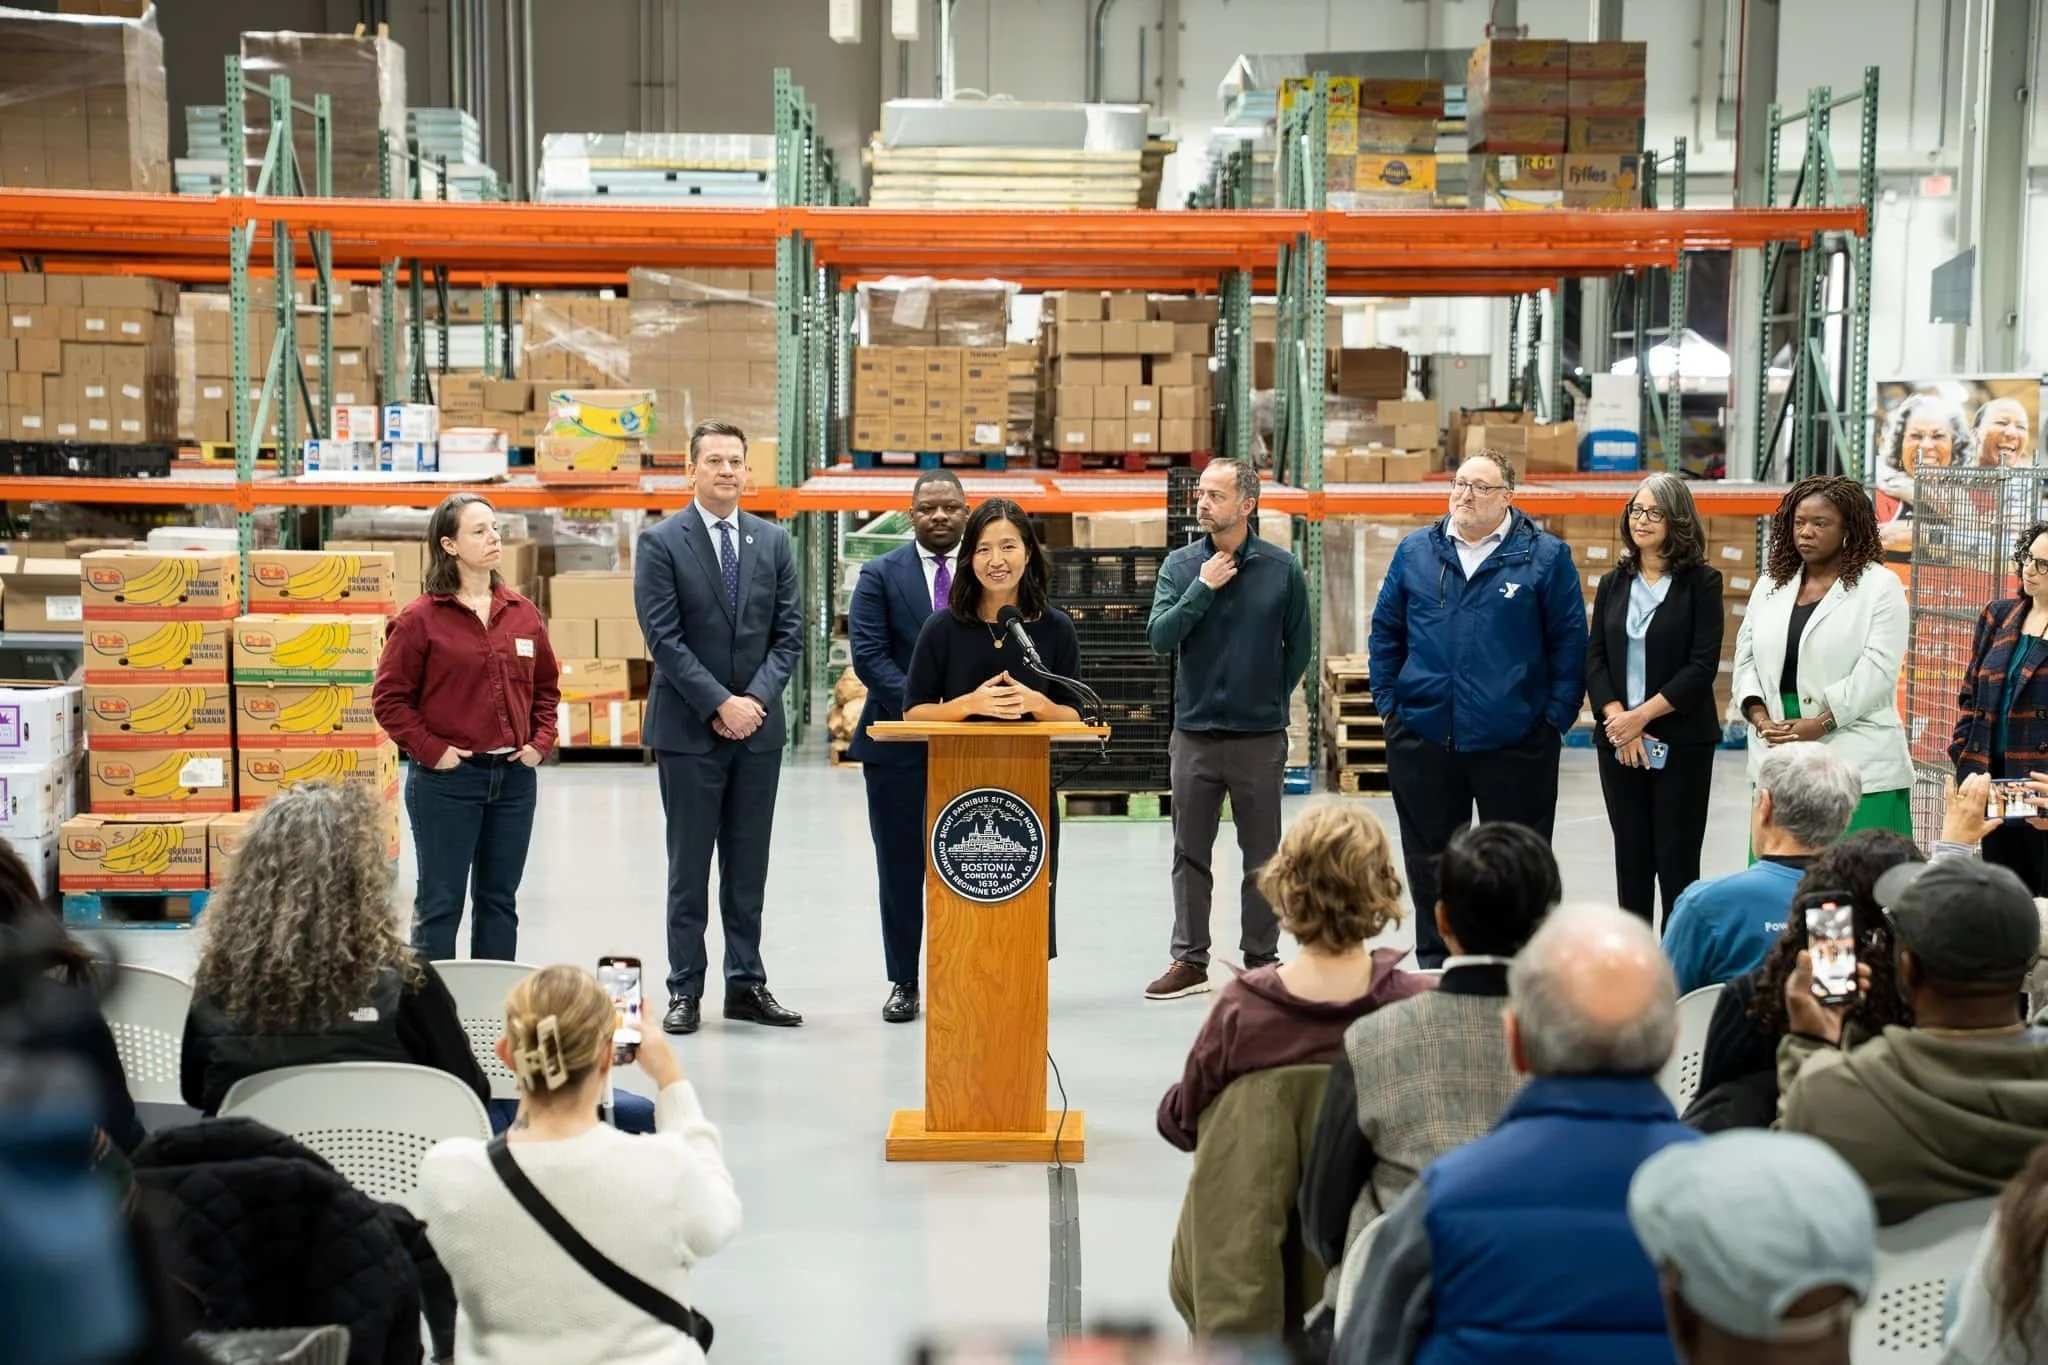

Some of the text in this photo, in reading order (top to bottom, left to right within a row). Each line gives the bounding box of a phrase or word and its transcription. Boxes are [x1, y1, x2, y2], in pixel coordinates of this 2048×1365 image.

[259, 566, 286, 577] Dole
[93, 571, 121, 582] Dole
[347, 576, 379, 584] PREMIUM
[186, 580, 219, 588] PREMIUM
[186, 588, 219, 597] BANANAS
[347, 585, 380, 593] BANANAS
[96, 634, 124, 645] Dole
[244, 635, 271, 645] Dole
[189, 643, 223, 651] PREMIUM
[189, 651, 223, 660] BANANAS
[100, 699, 127, 711] Dole
[250, 700, 275, 711] Dole
[191, 707, 225, 716] PREMIUM
[340, 707, 373, 715] PREMIUM
[191, 716, 226, 725] BANANAS
[103, 765, 130, 776] Dole
[253, 762, 280, 773] Dole
[940, 795, 1038, 842] SICUT PATRIBUS SIT DEUS NOBIS
[74, 839, 102, 850] Dole
[167, 847, 202, 855] PREMIUM
[167, 856, 203, 864] BANANAS
[938, 841, 955, 876] CIVITATIS
[991, 877, 1023, 896] DONATA
[961, 863, 1016, 872] BOSTONIA
[964, 872, 1013, 880] CONDITA AD
[978, 880, 999, 888] 1630
